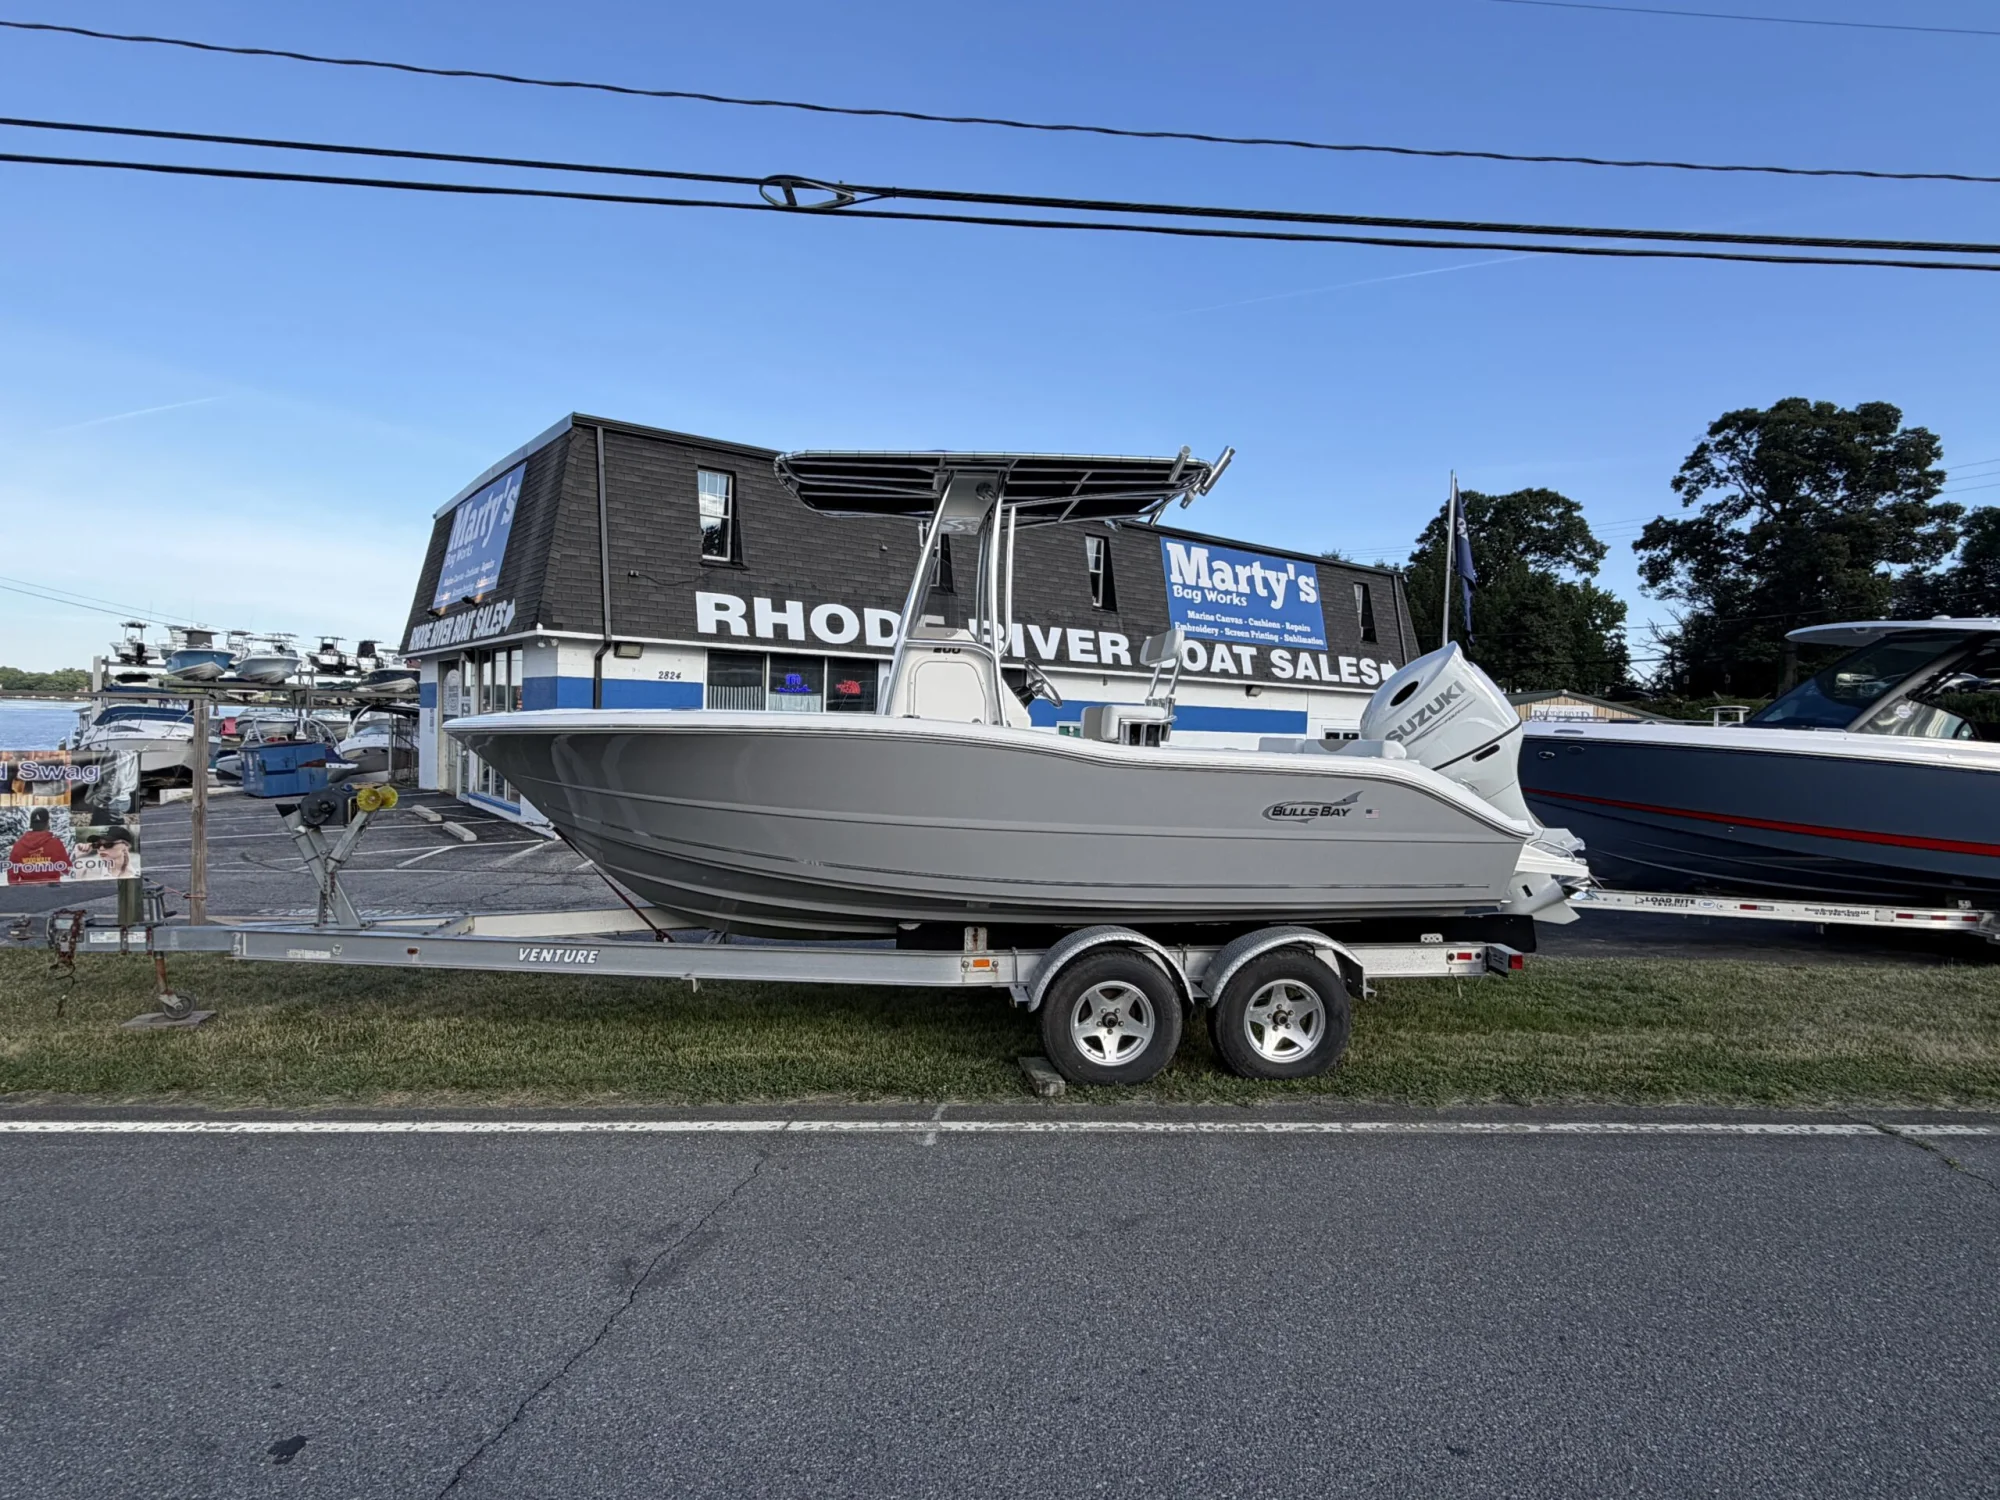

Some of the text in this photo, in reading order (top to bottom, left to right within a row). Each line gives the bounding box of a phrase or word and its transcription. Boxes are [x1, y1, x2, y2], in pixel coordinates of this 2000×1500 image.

[446, 475, 520, 552] Marty's
[1166, 542, 1318, 610] Marty's
[1173, 585, 1248, 607] Bag Works
[472, 599, 508, 640] SALES
[1187, 610, 1312, 633] Marine Canvas Cushions Repairs
[1175, 621, 1325, 646] Embroidery Screen Printing Sublimation
[1146, 636, 1257, 676] OAT
[1270, 648, 1380, 686] SALES
[658, 671, 682, 680] 2824
[1385, 680, 1466, 743] SUZUKI
[19, 761, 101, 785] Swag
[518, 947, 600, 964] VENTURE
